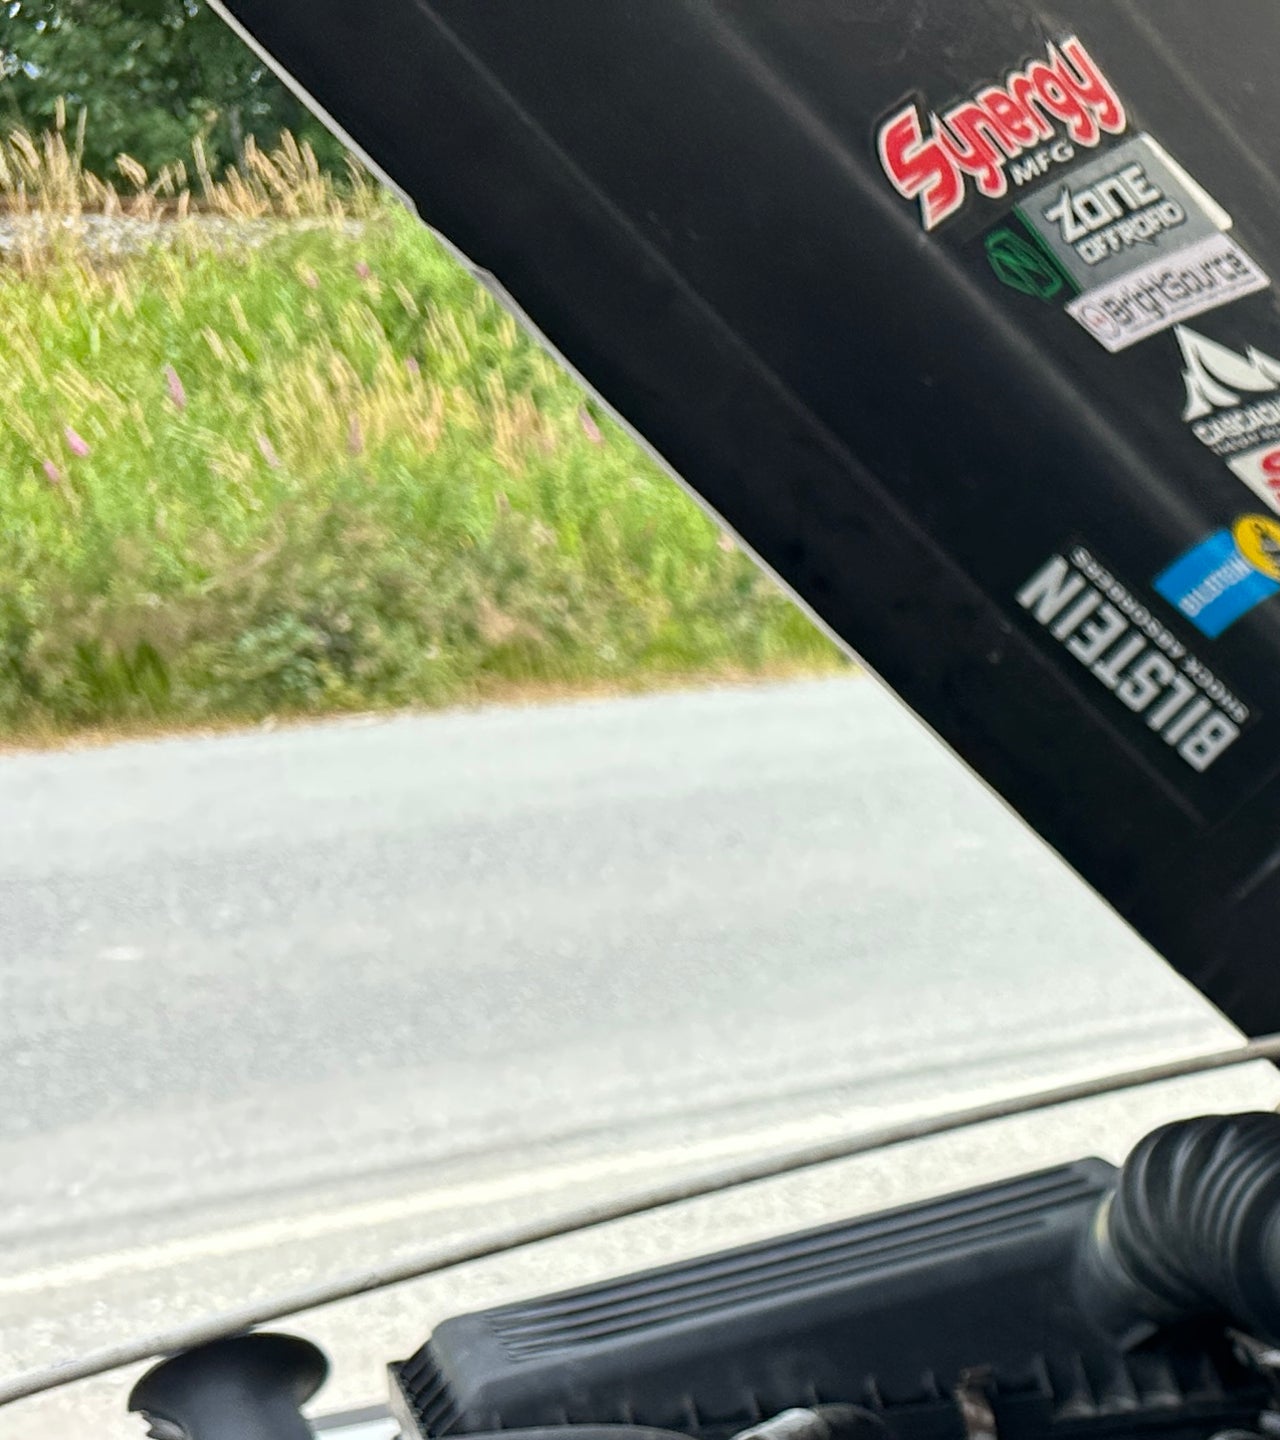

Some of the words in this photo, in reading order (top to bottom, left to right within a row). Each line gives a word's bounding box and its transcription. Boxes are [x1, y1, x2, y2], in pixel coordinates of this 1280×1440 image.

[878, 34, 1128, 232] Synergy
[1009, 139, 1074, 186] MFG
[1068, 546, 1188, 659] ABSORBERS
[1014, 553, 1241, 773] BILSTEIN
[1180, 652, 1250, 724] SHOCK
